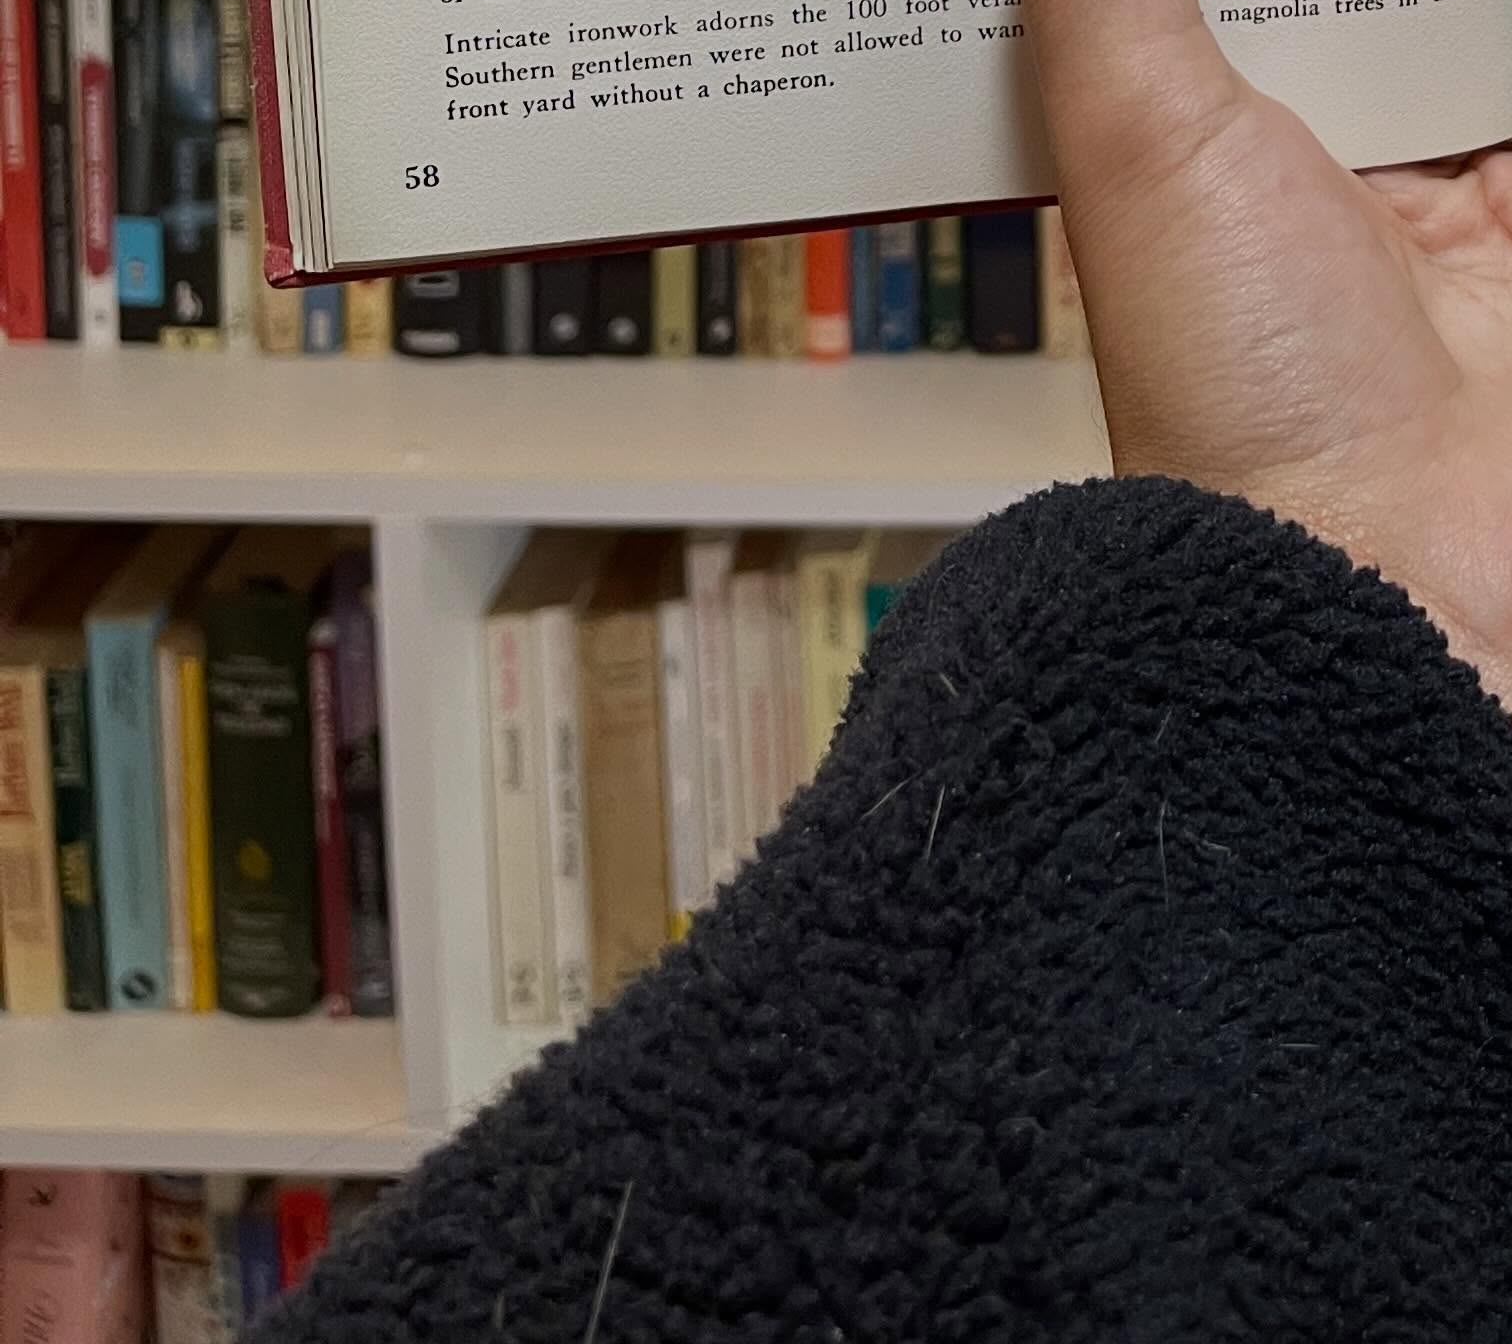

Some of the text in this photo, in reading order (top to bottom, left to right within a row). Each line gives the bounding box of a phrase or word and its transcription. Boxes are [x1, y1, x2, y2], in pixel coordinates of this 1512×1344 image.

[446, 73, 835, 121] front yard without a chaperon.
[405, 164, 440, 190] 58
